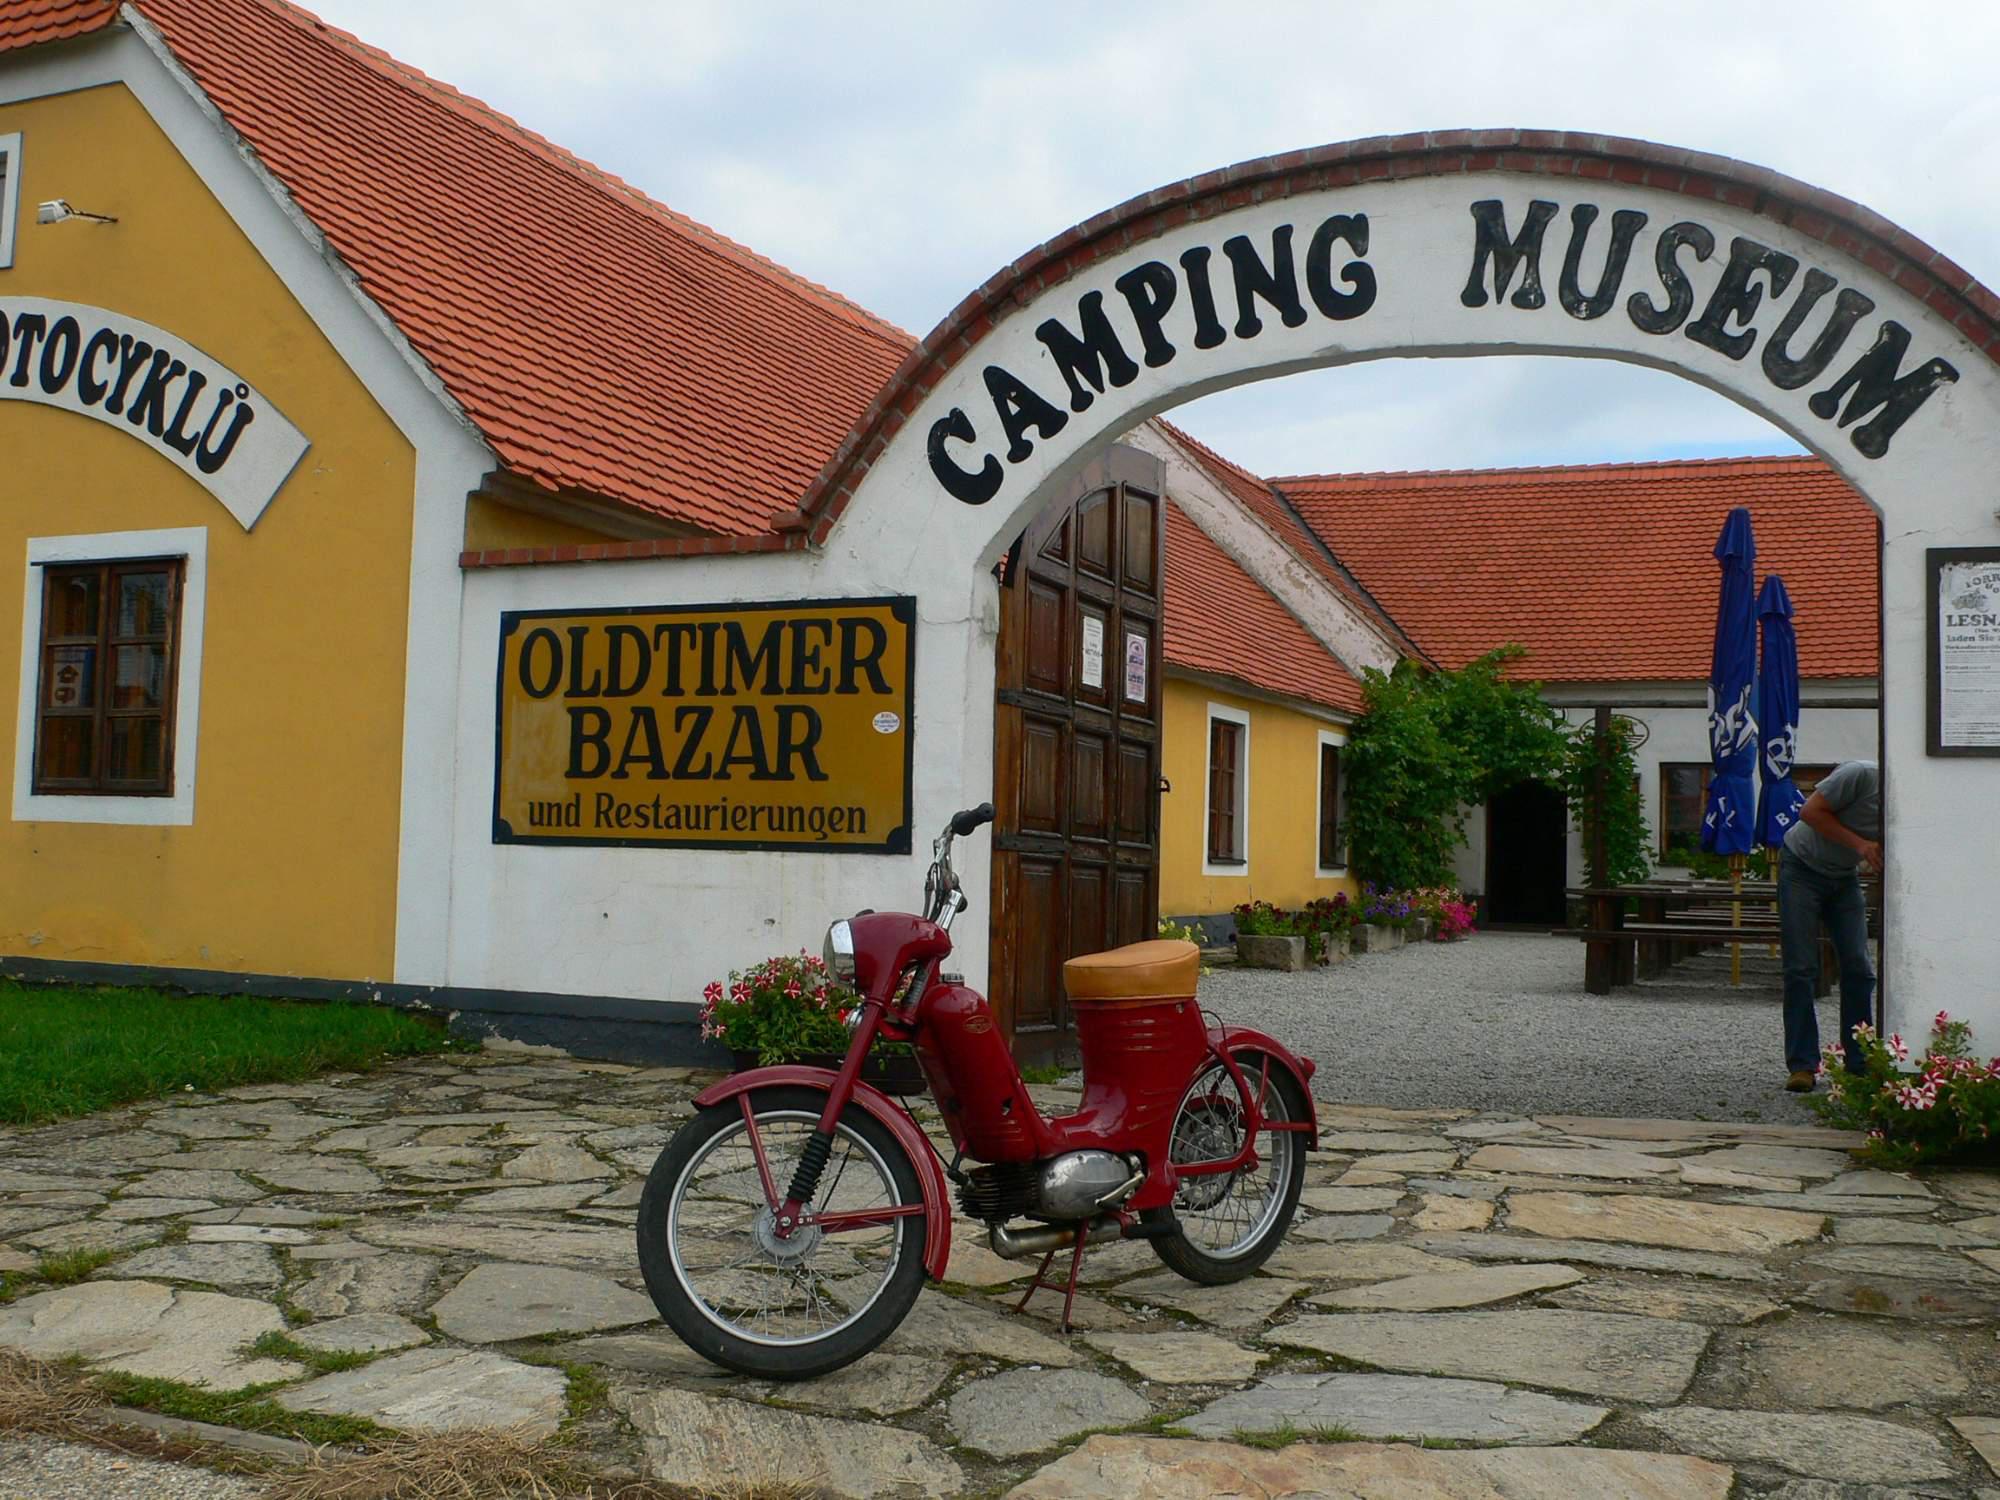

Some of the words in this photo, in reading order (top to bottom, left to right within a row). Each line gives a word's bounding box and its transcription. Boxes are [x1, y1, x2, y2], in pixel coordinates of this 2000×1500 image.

[0, 309, 254, 474] TOCYKLŮ
[928, 213, 1377, 505] CAMPING
[1460, 199, 1960, 459] MUSEUM
[518, 617, 893, 699] OLDTIMER
[1946, 614, 2000, 627] LESN
[564, 705, 829, 781] BAZAR
[528, 792, 581, 828] und
[594, 792, 867, 840] Restaurierungen
